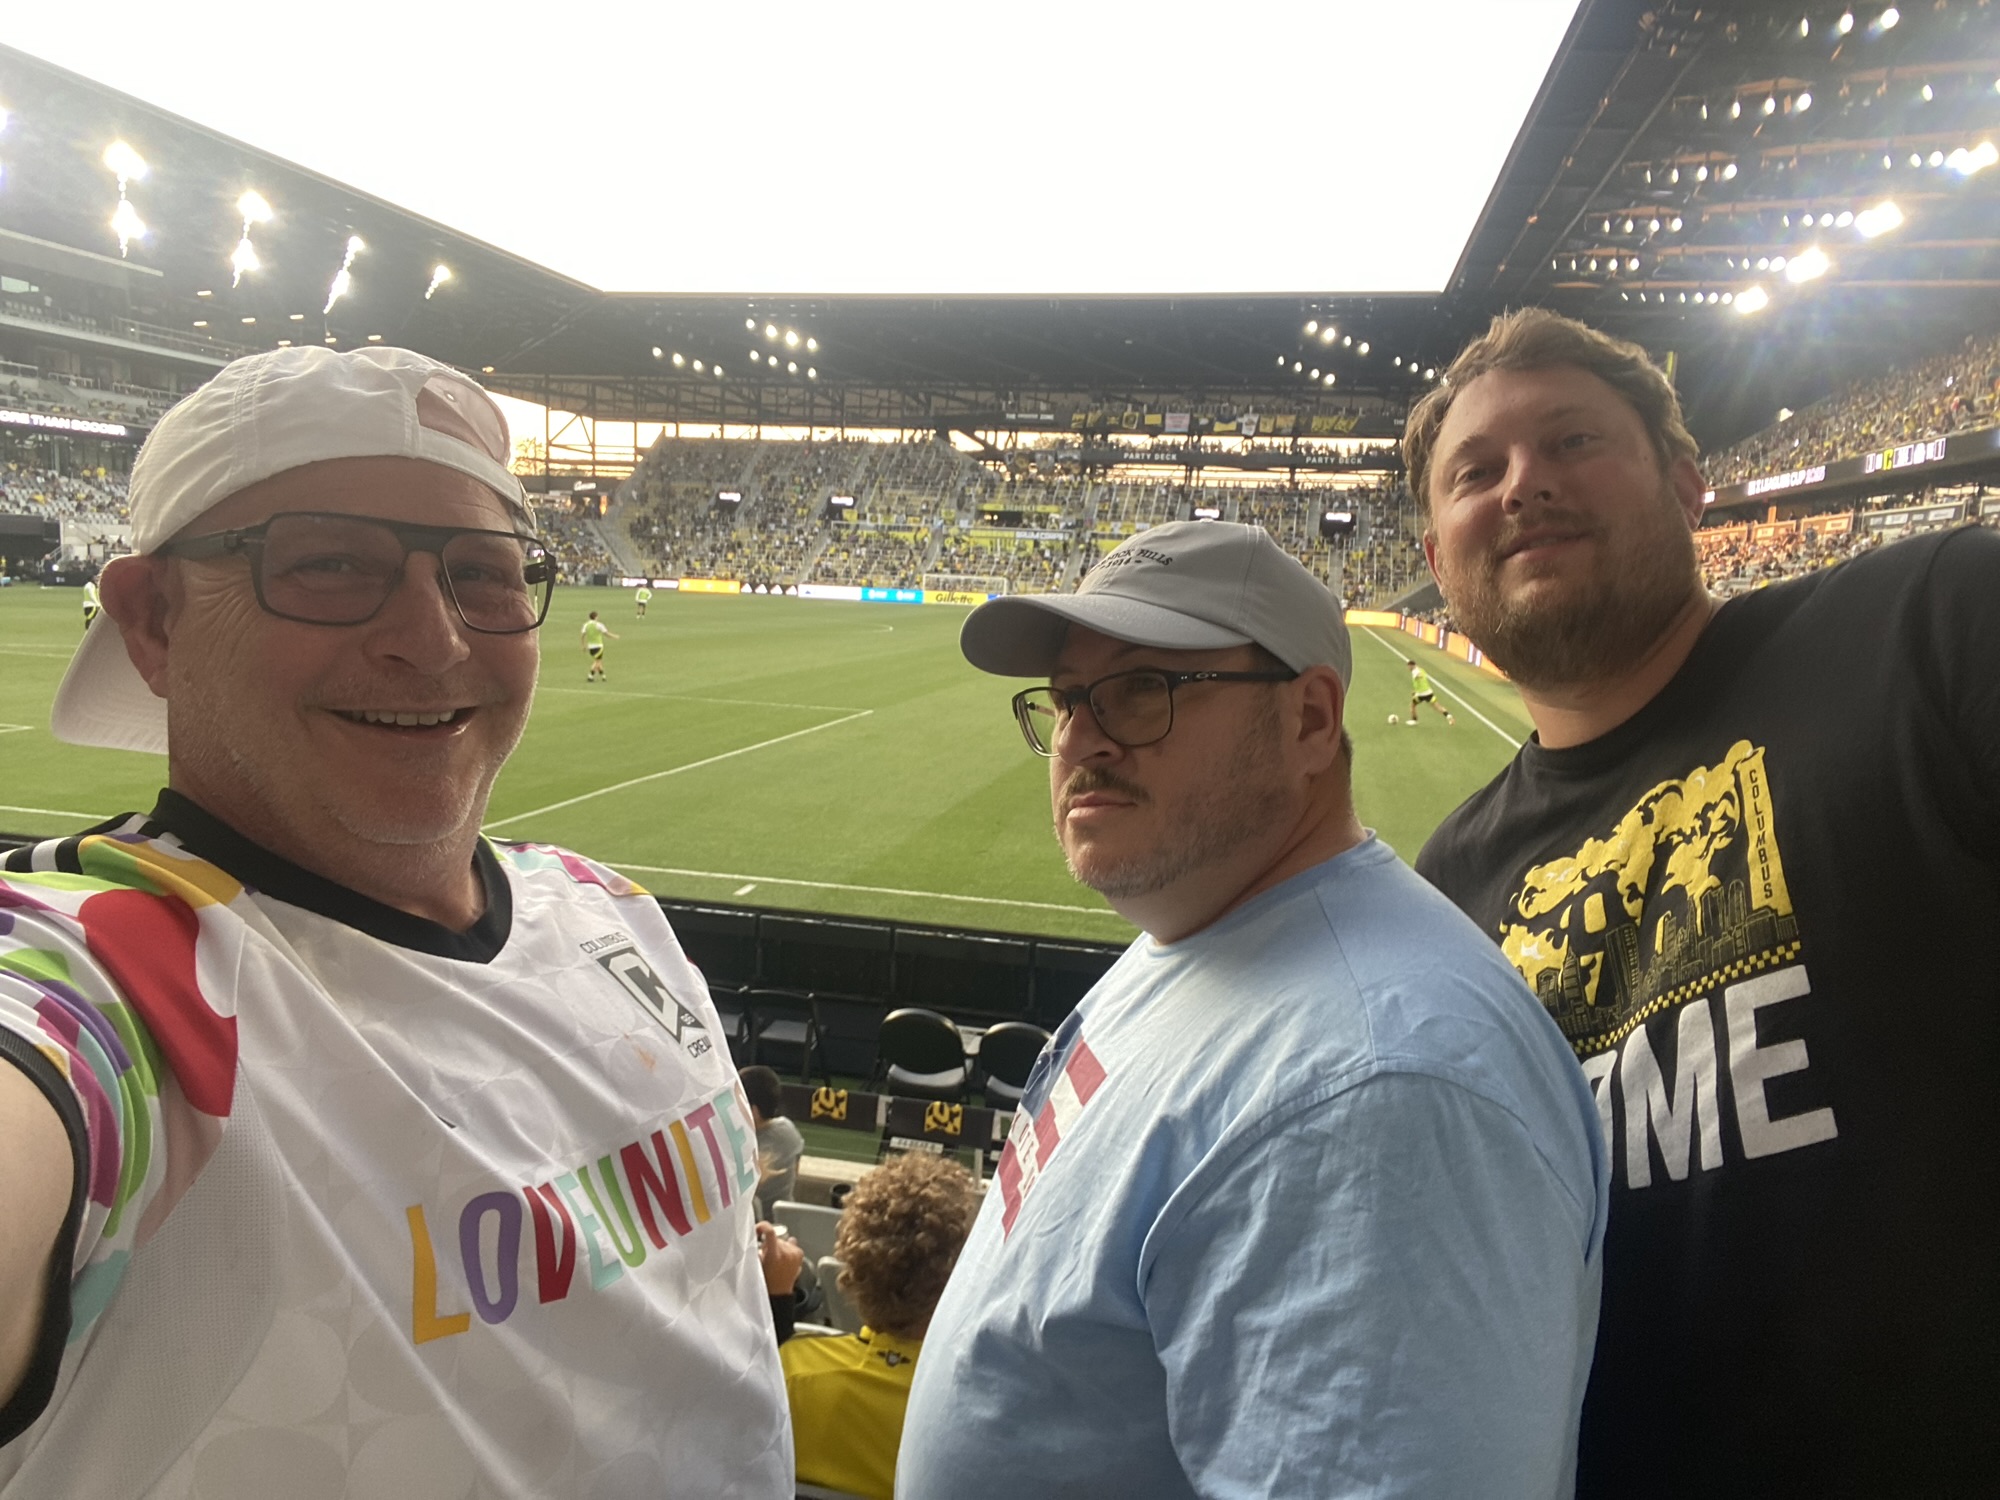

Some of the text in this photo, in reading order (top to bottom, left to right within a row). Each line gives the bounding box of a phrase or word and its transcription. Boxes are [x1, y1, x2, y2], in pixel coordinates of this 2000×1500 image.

[1124, 452, 1177, 461] PARTY DECK
[1305, 456, 1363, 465] PARTY DECK
[1137, 549, 1173, 566] HILLS
[935, 591, 974, 604] Gillette
[1748, 769, 1773, 899] COLUMBUS
[579, 932, 629, 954] COLUMBUS
[687, 1036, 712, 1058] CREW
